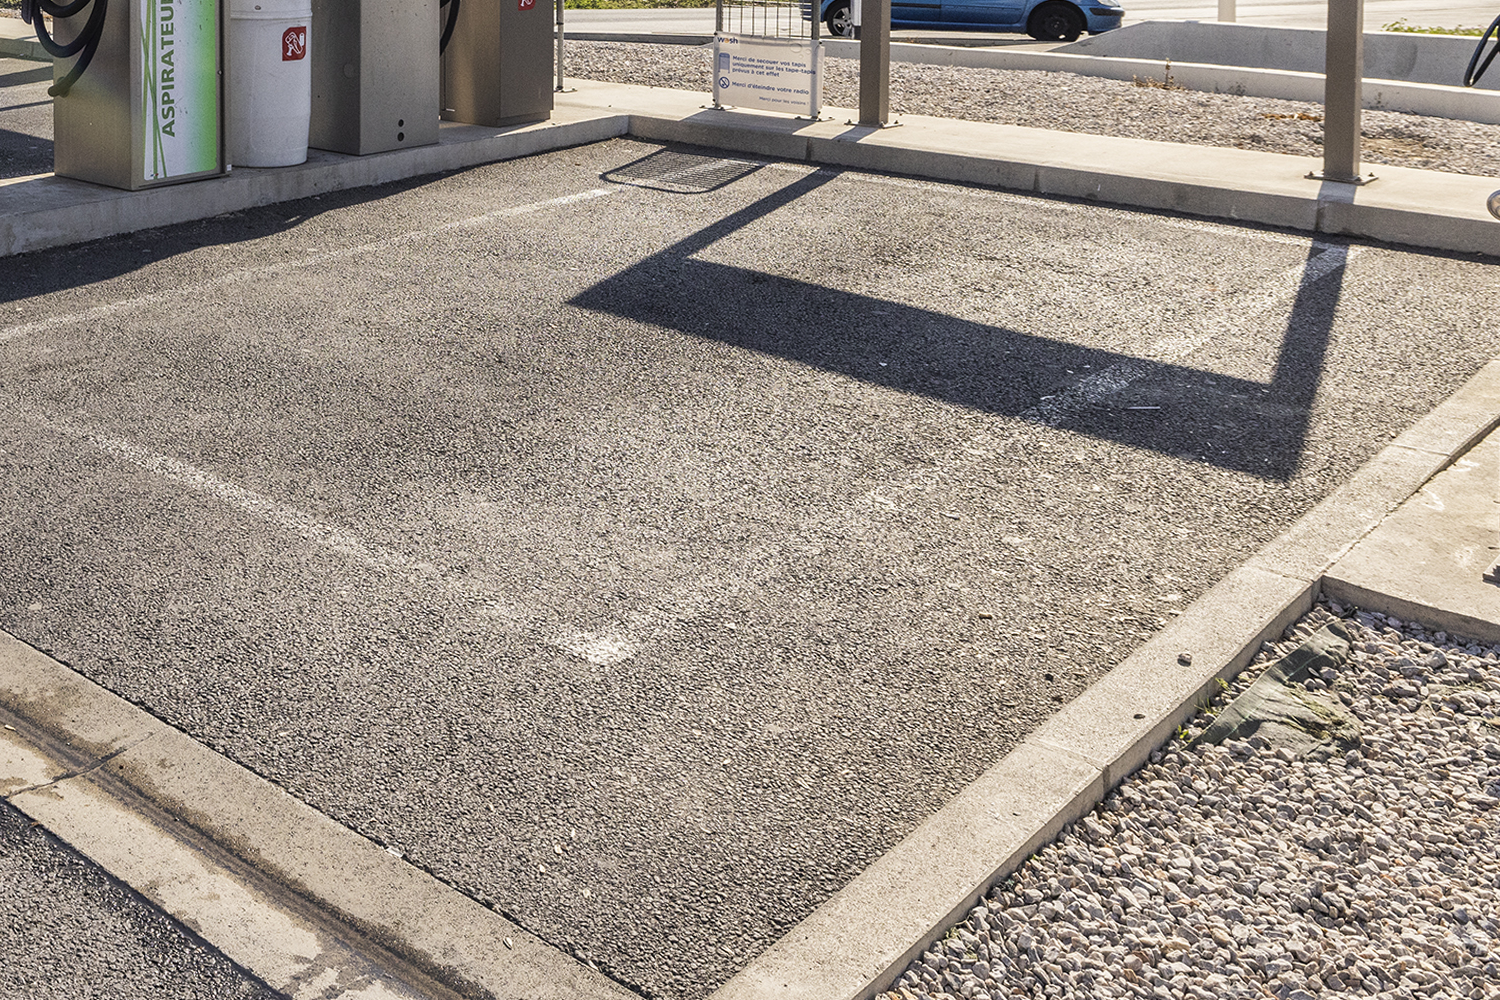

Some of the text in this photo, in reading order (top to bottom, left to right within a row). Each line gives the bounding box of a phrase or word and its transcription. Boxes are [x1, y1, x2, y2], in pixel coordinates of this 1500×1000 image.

[717, 36, 739, 44] wash
[732, 62, 765, 70] uniquement
[785, 67, 816, 75] tape-tapis
